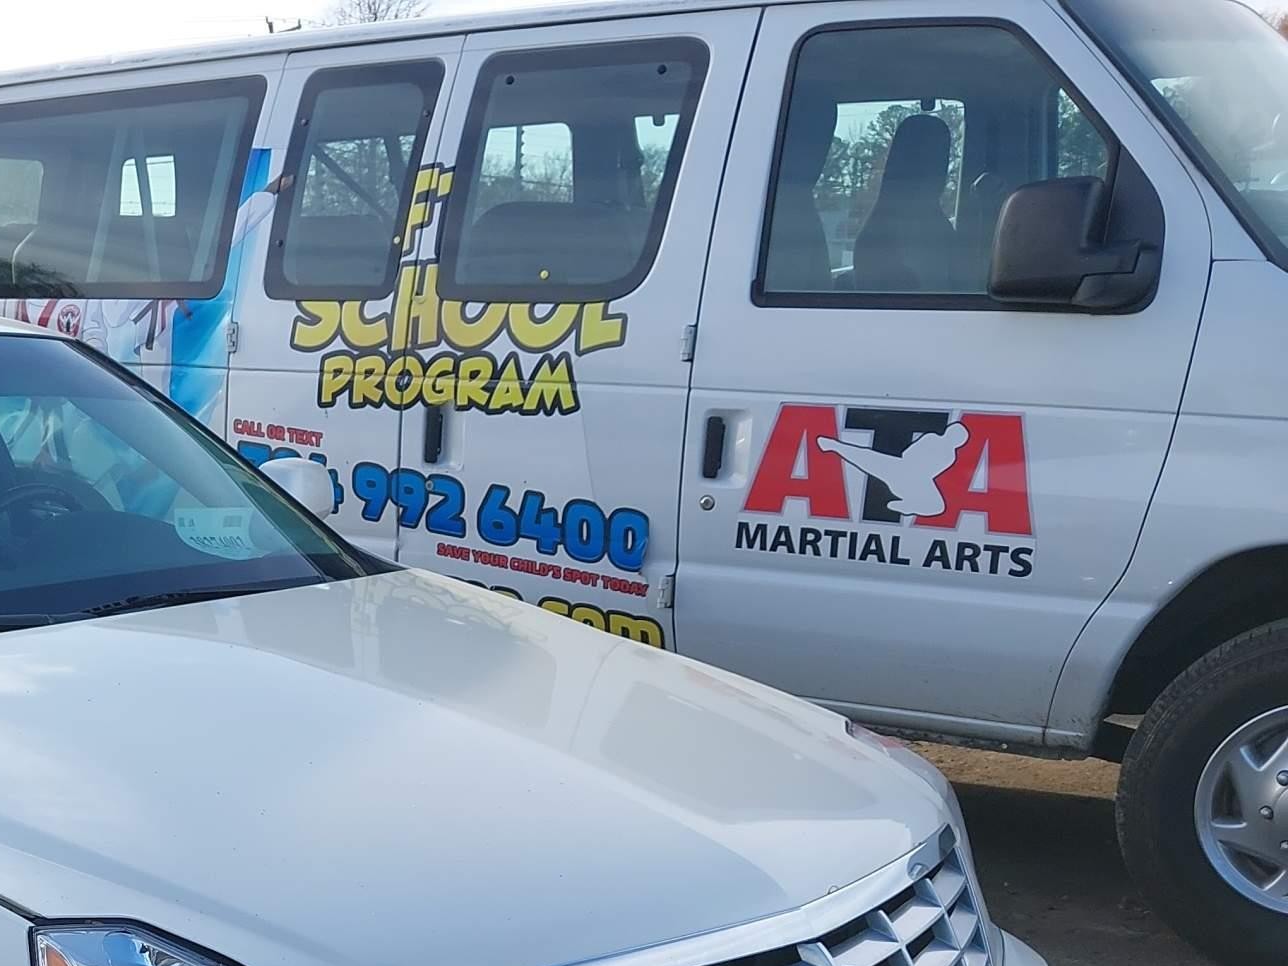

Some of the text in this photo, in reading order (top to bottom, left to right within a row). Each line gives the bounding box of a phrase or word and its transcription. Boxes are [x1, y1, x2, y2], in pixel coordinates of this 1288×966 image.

[290, 261, 627, 354] SCHOOL
[318, 352, 579, 414] PROGRAM
[233, 419, 323, 447] CALL OR TEXT
[741, 401, 1035, 537] ATA
[352, 462, 466, 538] 992
[477, 483, 650, 572] 6400
[436, 543, 649, 597] SAVE YOUR CHILD'S SPOT TODAY
[734, 521, 1034, 578] MARTIAL ARTS
